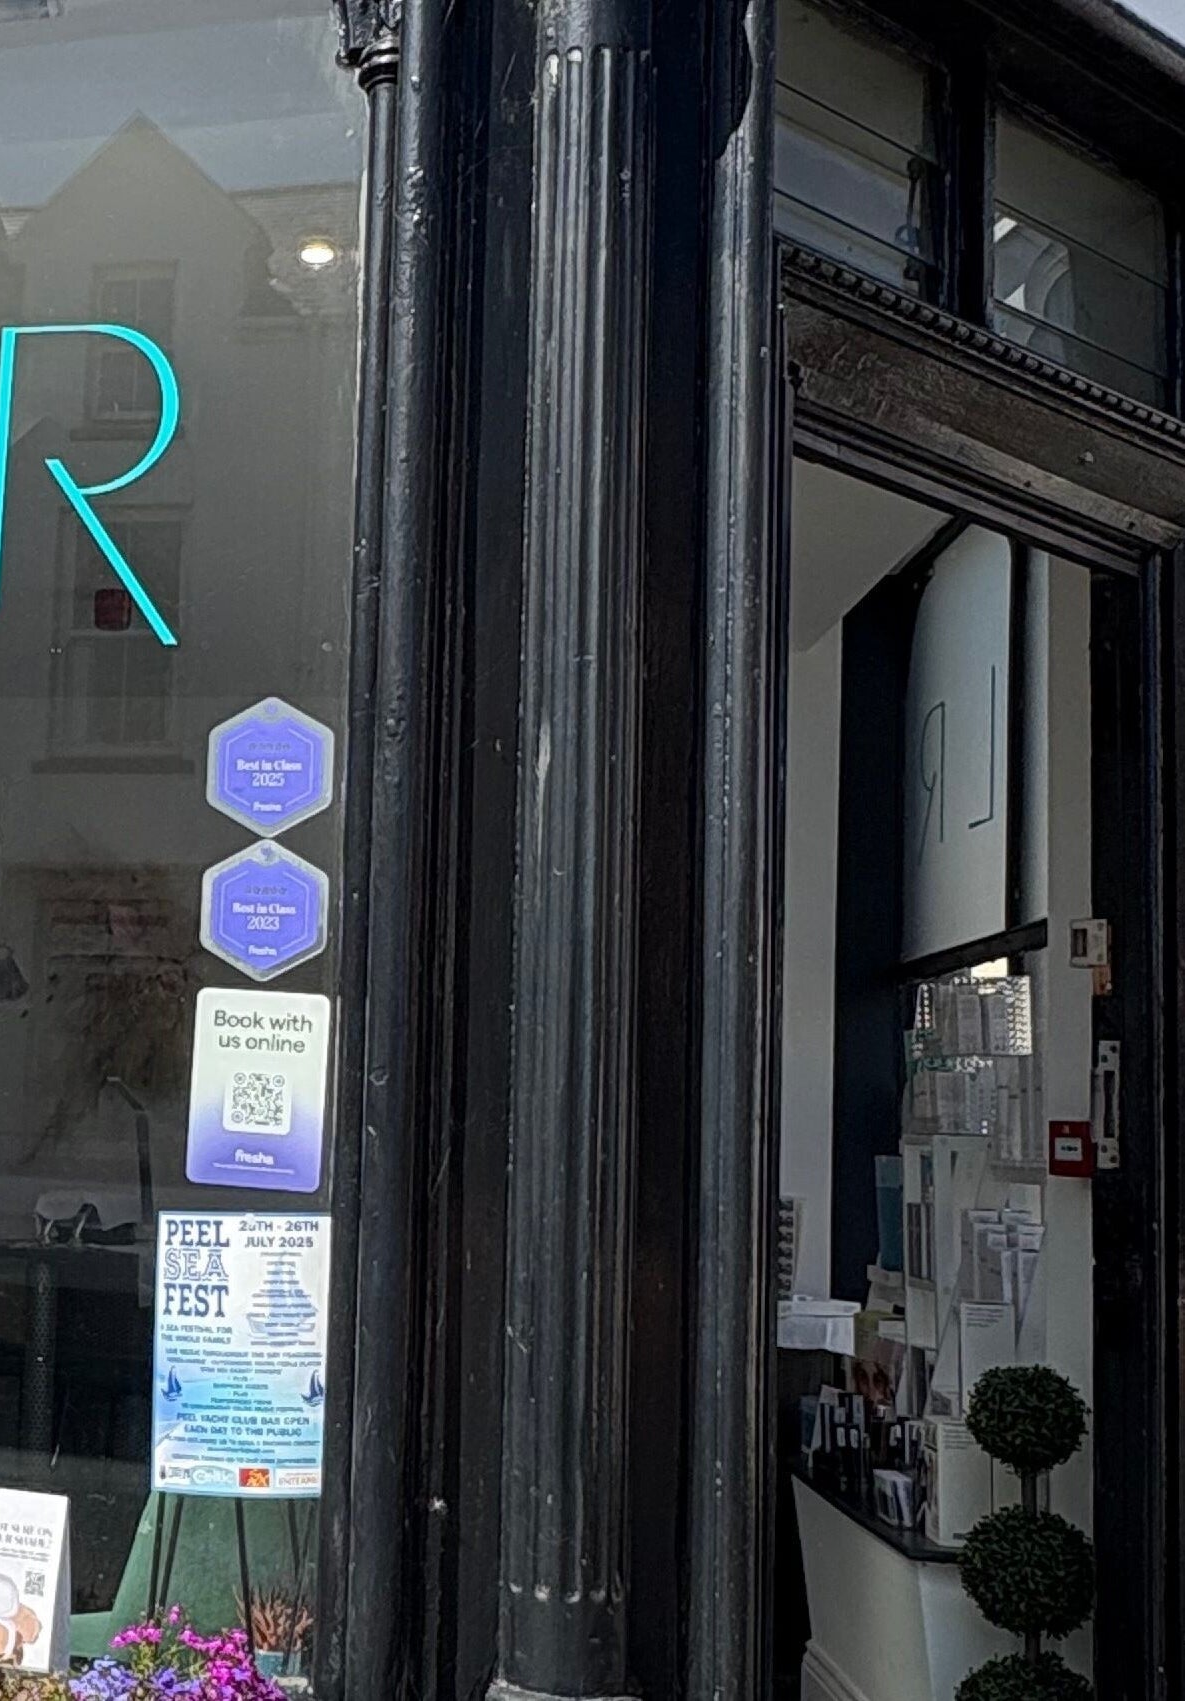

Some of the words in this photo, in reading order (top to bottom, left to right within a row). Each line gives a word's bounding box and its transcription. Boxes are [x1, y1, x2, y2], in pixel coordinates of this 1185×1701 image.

[237, 758, 260, 771] Best
[262, 758, 273, 771] in
[275, 758, 303, 772] Class
[252, 772, 286, 788] 2025
[232, 902, 255, 914] Best
[257, 902, 268, 914] in
[269, 903, 298, 915] Class
[247, 916, 281, 931] 2023
[214, 1009, 265, 1030] Book
[269, 1012, 313, 1033] with
[218, 1034, 241, 1049] us
[245, 1033, 306, 1053] online
[235, 1148, 274, 1166] fresha
[165, 1219, 230, 1247] PEEL
[284, 1221, 319, 1232] 26TH
[245, 1236, 275, 1248] JULY
[278, 1237, 314, 1248] 2025
[163, 1248, 229, 1281] SEA
[163, 1282, 229, 1317] FEST
